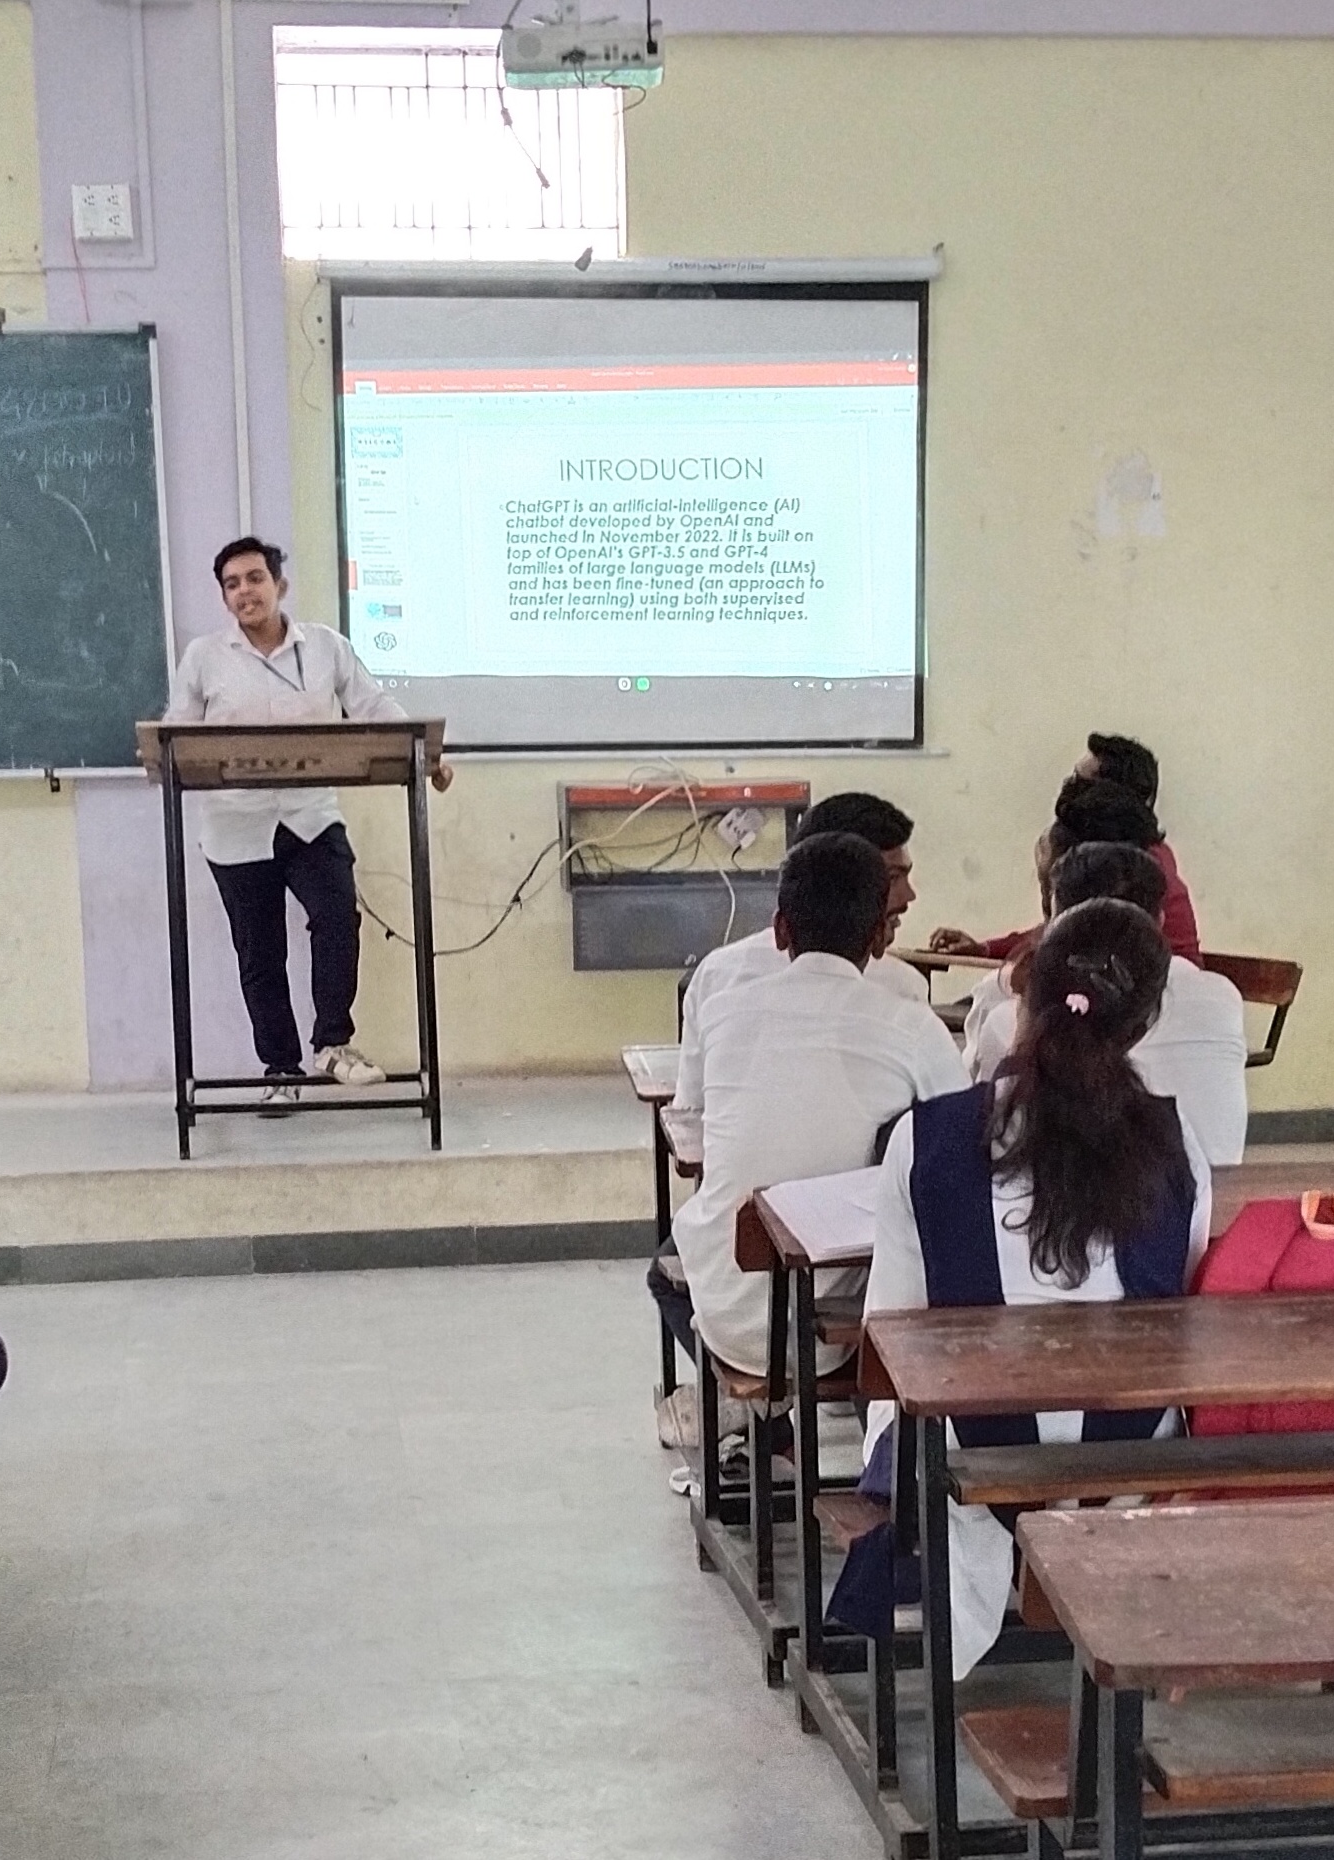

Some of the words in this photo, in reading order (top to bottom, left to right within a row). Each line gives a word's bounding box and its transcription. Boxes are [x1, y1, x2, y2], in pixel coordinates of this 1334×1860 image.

[560, 457, 763, 482] INTRODUCTION
[505, 500, 570, 513] ChatGPT
[574, 499, 584, 512] is
[589, 501, 608, 512] an
[613, 498, 768, 514] artificial-intelligence
[774, 498, 800, 514] (AI)
[506, 515, 564, 528] chatbot
[569, 515, 651, 530] developed
[656, 515, 675, 529] by
[680, 514, 739, 529] OpenAI
[744, 514, 774, 526] and
[506, 530, 578, 544] launched
[600, 530, 680, 543] November
[685, 529, 723, 542] 2022.
[728, 529, 738, 542] It
[742, 529, 752, 542] is
[757, 529, 789, 542] built
[794, 531, 813, 542] on
[507, 546, 531, 561] top
[536, 546, 551, 558] of
[555, 546, 623, 562] OpenAI's
[628, 545, 685, 558] GPT-3.5
[689, 545, 719, 558] and
[724, 545, 768, 558] GPT-4
[507, 562, 564, 574] families
[569, 562, 584, 574] of
[587, 561, 626, 577] large
[630, 561, 704, 576] language
[709, 561, 764, 573] models
[770, 560, 816, 577] (LLMs)
[509, 577, 538, 590] and
[542, 577, 568, 590] has
[573, 577, 611, 589] been
[616, 577, 694, 590] fine-tuned
[699, 577, 723, 592] (an
[729, 576, 805, 592] approach
[810, 577, 825, 589] to
[509, 593, 564, 606] transfer
[568, 592, 634, 608] learning)
[640, 592, 679, 607] using
[683, 592, 718, 605] both
[722, 592, 805, 608] supervised
[510, 608, 539, 620] and
[543, 607, 648, 620] reinforcement
[653, 607, 714, 623] learning
[719, 607, 808, 623] techniques.
